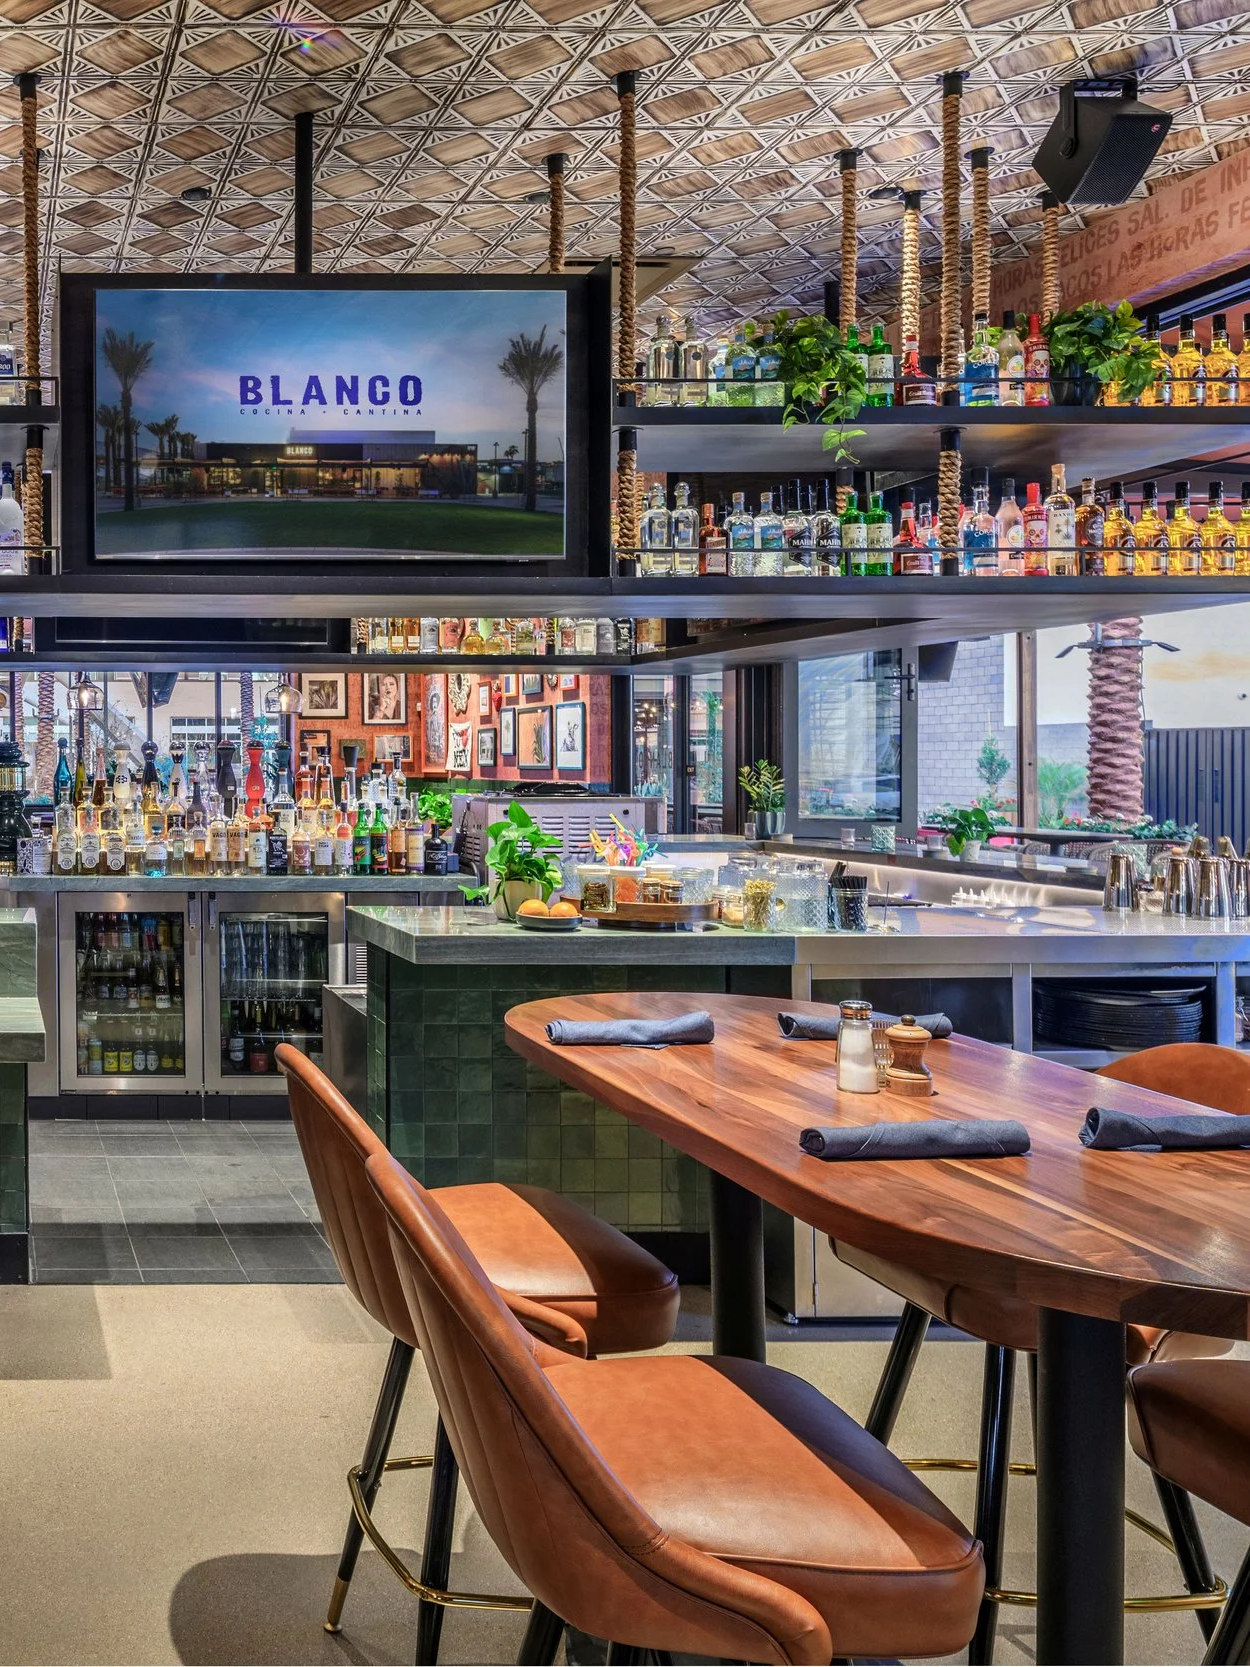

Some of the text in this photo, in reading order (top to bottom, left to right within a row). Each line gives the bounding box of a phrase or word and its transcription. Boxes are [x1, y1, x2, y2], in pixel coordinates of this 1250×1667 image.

[1180, 177, 1207, 214] DE
[239, 374, 422, 406] BLANCO
[286, 446, 313, 454] BLANCO
